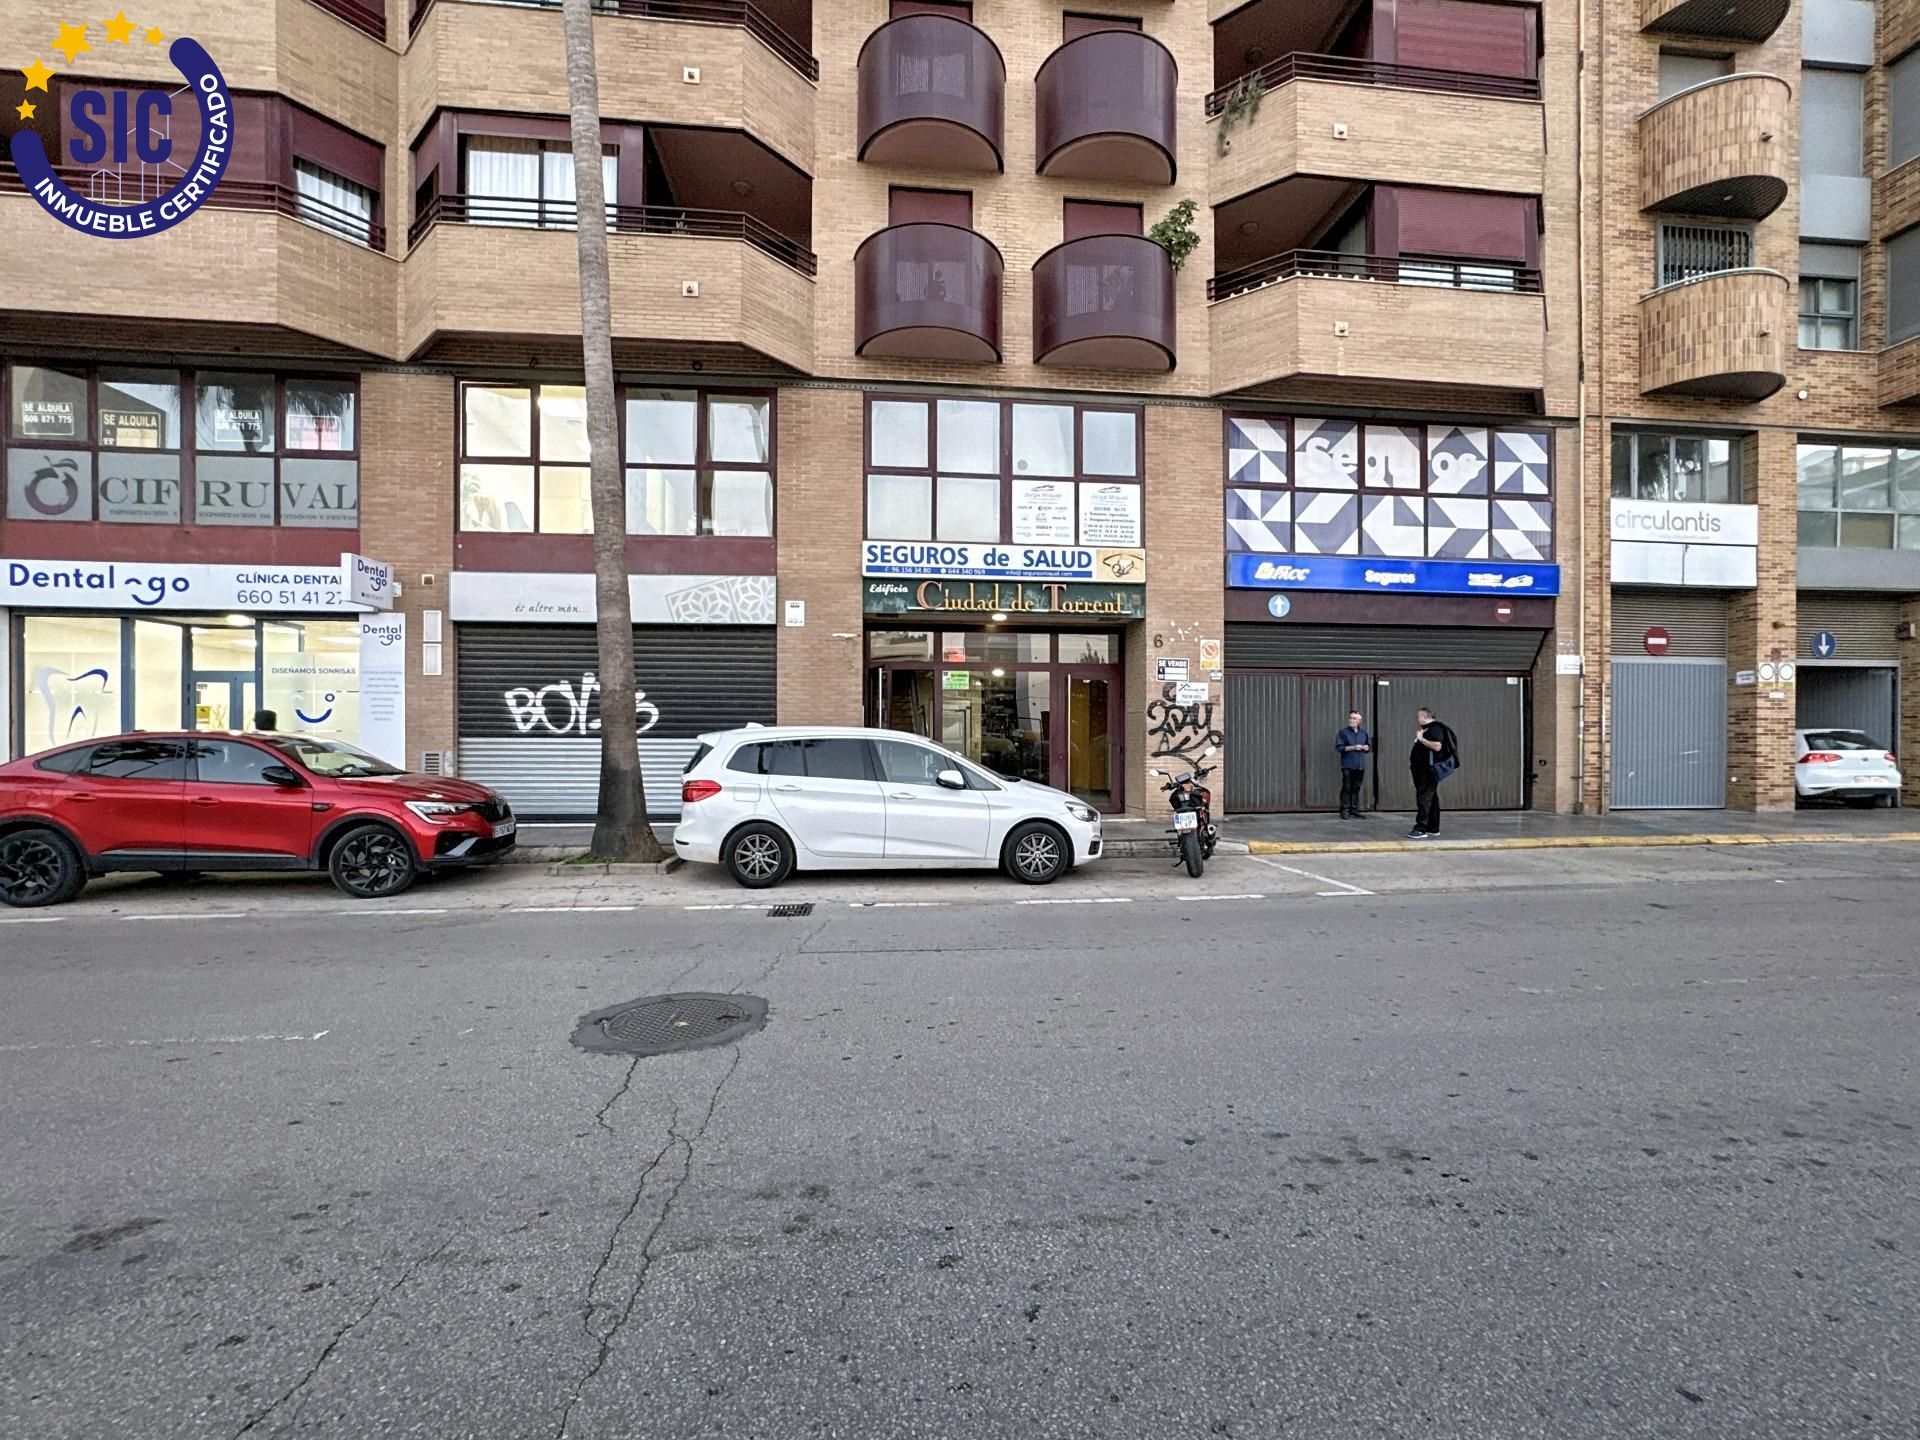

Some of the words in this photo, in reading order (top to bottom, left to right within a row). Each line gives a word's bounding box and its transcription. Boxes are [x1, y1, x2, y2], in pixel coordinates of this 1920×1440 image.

[24, 403, 34, 413] SE
[37, 403, 70, 413] ALQUILA
[58, 415, 72, 424] 775
[103, 414, 116, 426] SE
[118, 415, 157, 427] ALQUILA
[229, 411, 260, 421] ALQUILA
[248, 422, 261, 430] 775
[1614, 510, 1721, 533] circulantis
[867, 545, 969, 565] SEGUROS
[983, 547, 1010, 567] de
[1023, 549, 1092, 569] SALUD
[357, 559, 388, 579] Dental
[10, 563, 115, 589] Dental
[236, 572, 290, 584] CLÍNICA
[1364, 569, 1416, 586] Seguros
[371, 577, 388, 592] go
[237, 590, 273, 604] 660
[279, 591, 295, 604] 51
[302, 591, 319, 604] 41
[916, 580, 999, 612] Ciudad
[1011, 584, 1034, 611] de
[1042, 583, 1123, 614] Torrent
[528, 601, 554, 613] altre
[362, 624, 402, 634] Dental
[381, 633, 402, 646] go
[1153, 633, 1164, 648] 6
